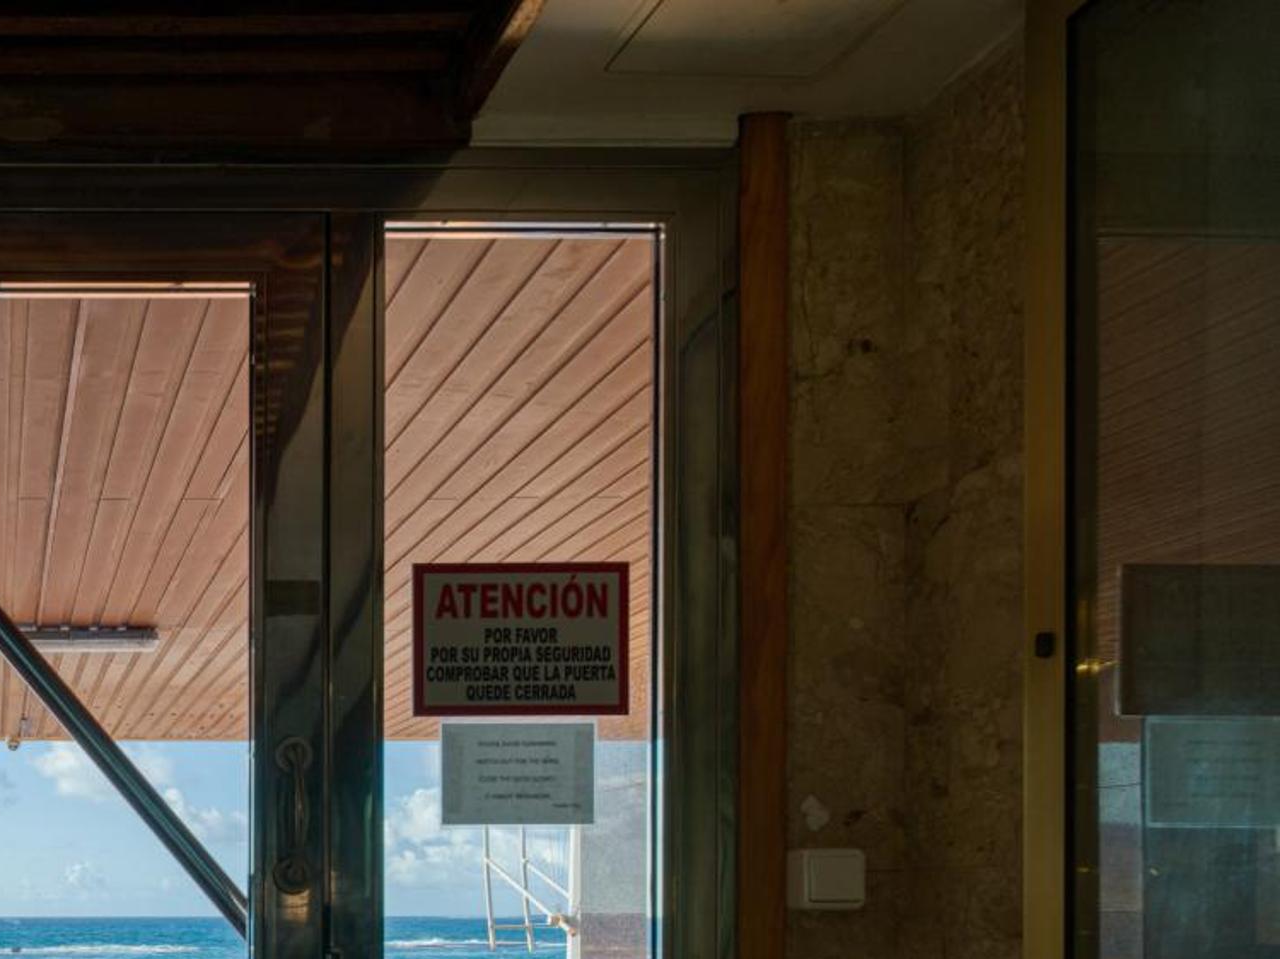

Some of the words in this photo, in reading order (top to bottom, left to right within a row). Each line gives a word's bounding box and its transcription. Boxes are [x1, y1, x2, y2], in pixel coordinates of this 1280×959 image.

[437, 574, 608, 618] ATENCIÓN
[484, 628, 513, 643] POR
[516, 628, 558, 643] FAVOR
[430, 646, 458, 662] POR
[462, 646, 480, 662] SU
[484, 646, 532, 662] PROPIA
[535, 646, 611, 662] SEGURIDAD
[426, 666, 509, 682] COMPROBAR
[513, 666, 541, 682] QUE
[544, 666, 561, 681] LA
[564, 665, 615, 681] PUERTA
[466, 684, 511, 700] QUEDE
[515, 684, 576, 700] CERRADA
